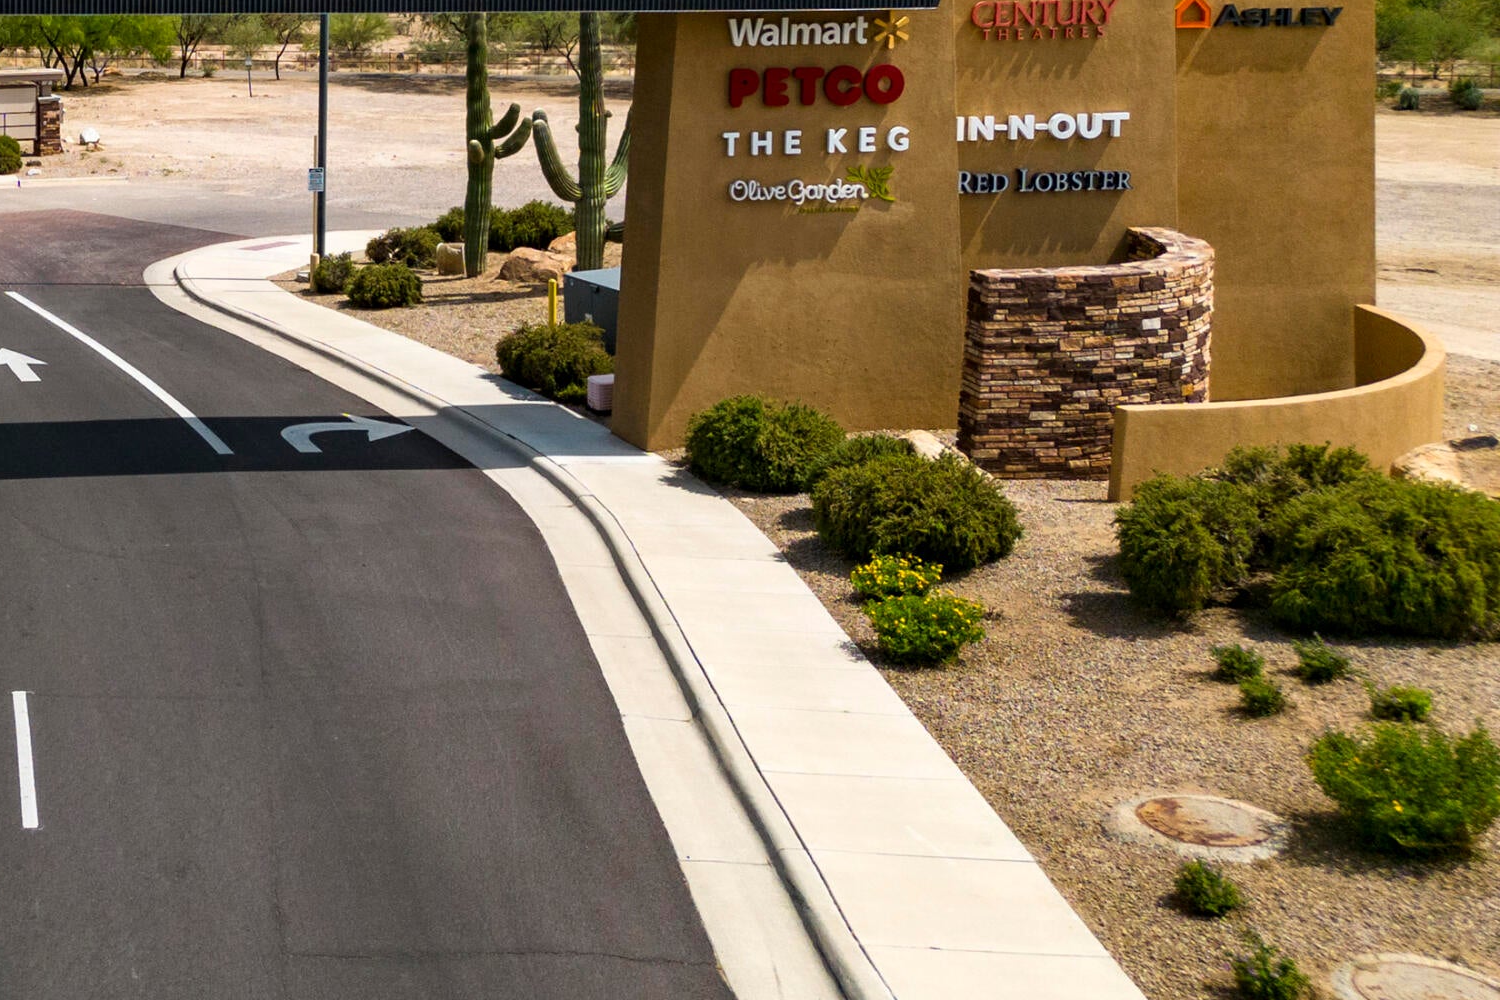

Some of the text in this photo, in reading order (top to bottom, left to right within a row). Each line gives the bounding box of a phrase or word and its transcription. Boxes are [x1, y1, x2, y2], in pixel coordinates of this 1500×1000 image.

[1213, 4, 1344, 28] ASHLEY
[728, 16, 868, 47] Walmart
[982, 26, 1106, 41] THEATRES
[729, 64, 905, 108] PETCO
[722, 126, 910, 157] THE KEG
[956, 112, 1130, 142] IN-N-OUT
[730, 178, 865, 205] Olive Garden
[958, 167, 1133, 195] RED LOBSTER
